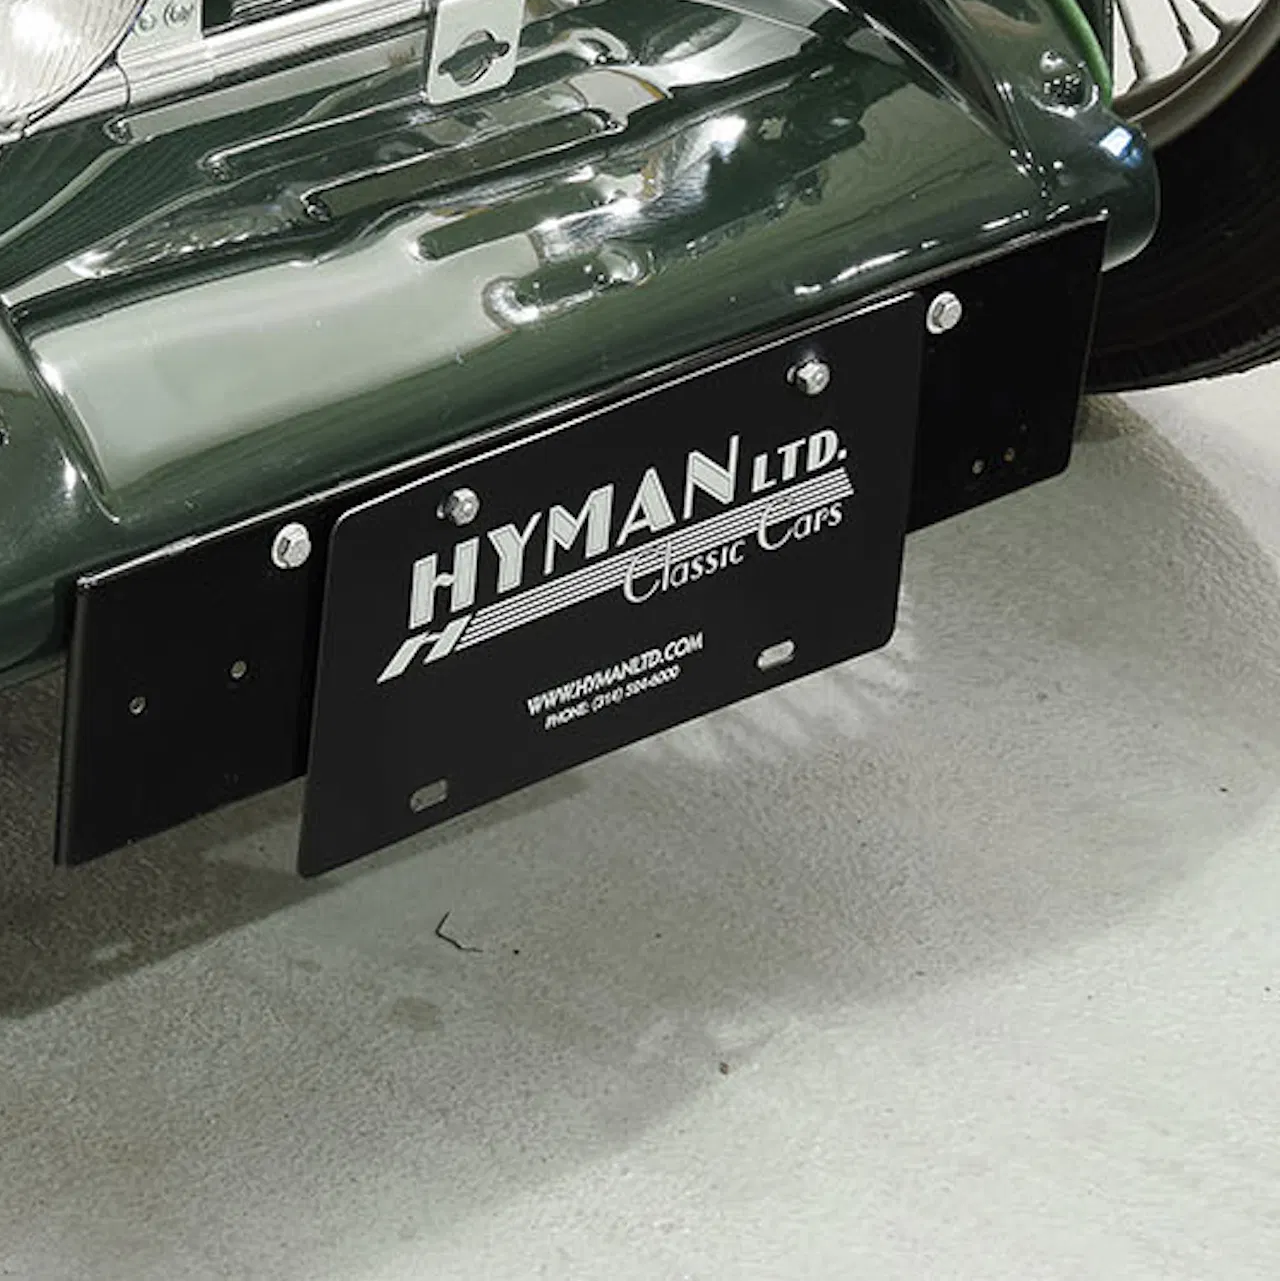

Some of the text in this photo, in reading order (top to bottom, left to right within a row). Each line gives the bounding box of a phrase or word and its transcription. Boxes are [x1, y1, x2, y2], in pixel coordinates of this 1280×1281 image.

[409, 428, 848, 629] HYMAN LTD.
[623, 497, 843, 603] Classic Cars
[527, 631, 704, 716] WWW.HYMANLTD.COM
